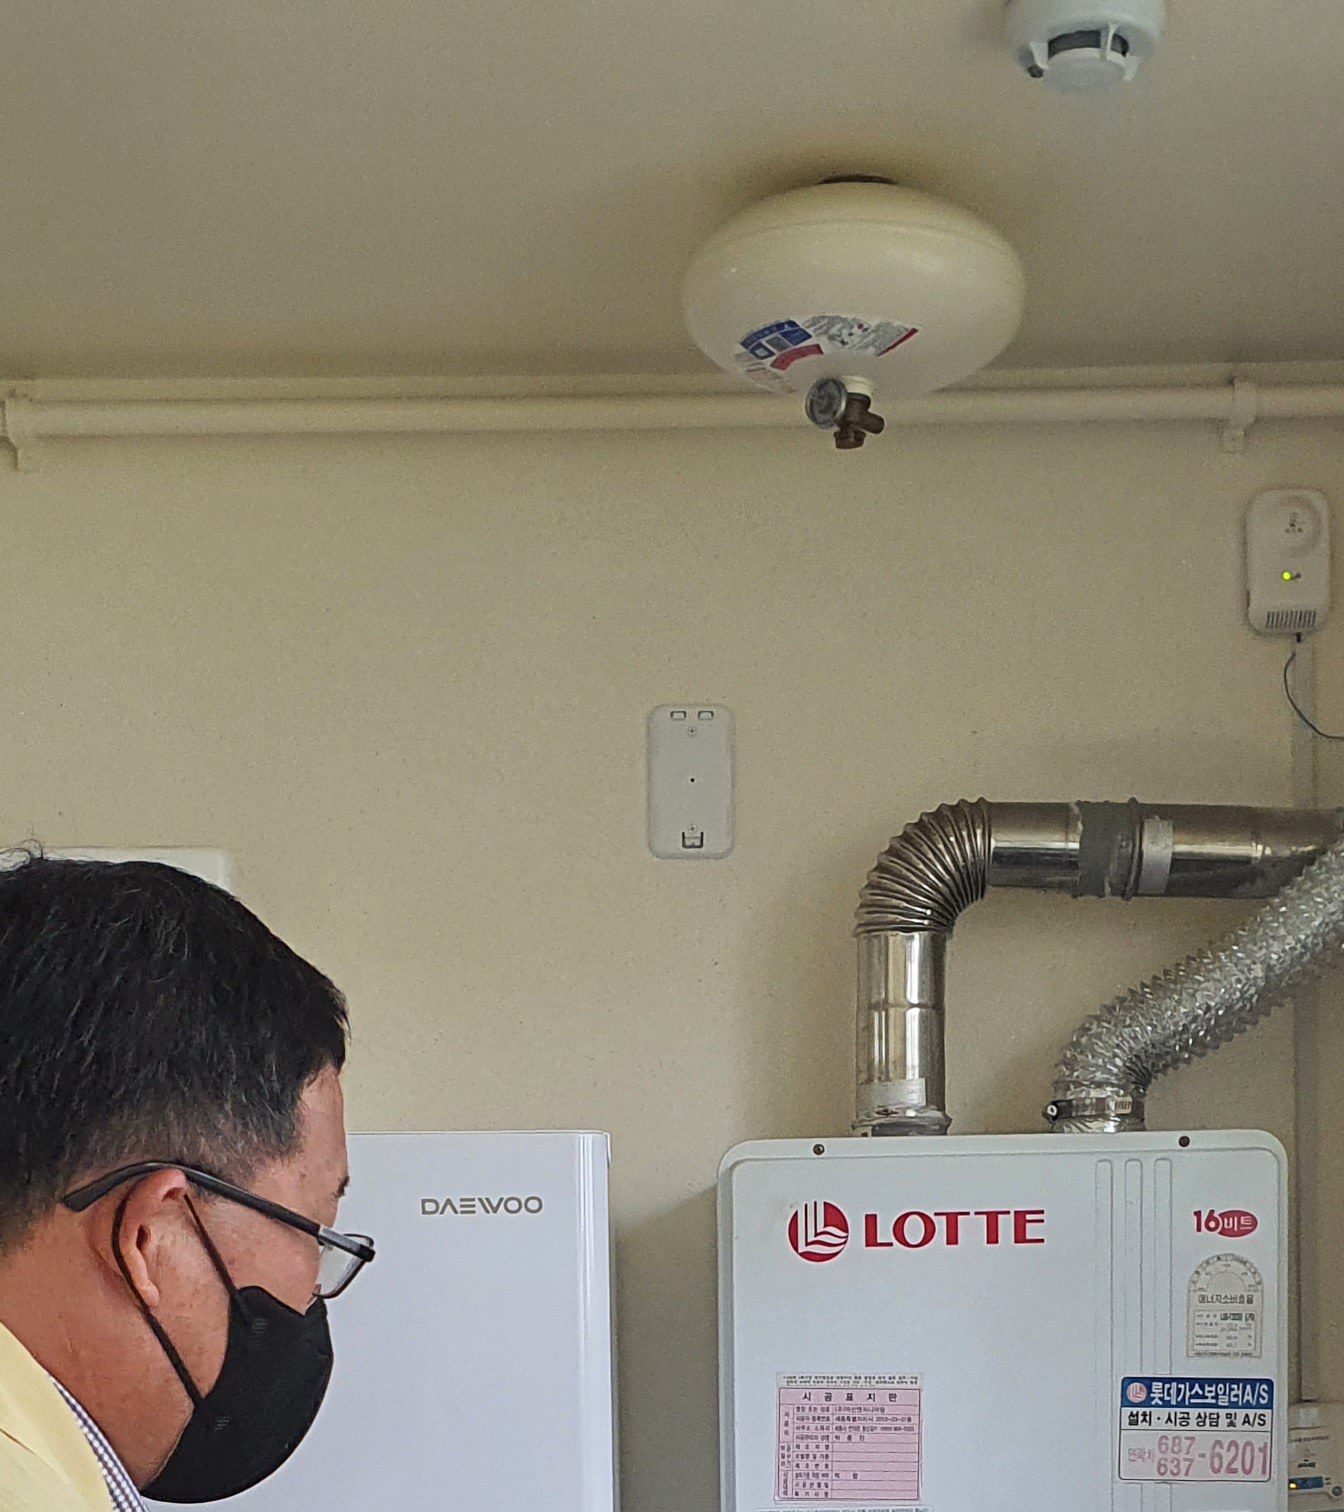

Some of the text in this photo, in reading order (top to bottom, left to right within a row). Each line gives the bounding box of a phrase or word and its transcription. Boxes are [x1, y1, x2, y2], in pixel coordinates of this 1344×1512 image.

[420, 1195, 544, 1216] DAEWOO
[864, 1210, 1046, 1249] LOTTE
[1192, 1208, 1255, 1234] 16비트
[1149, 1381, 1270, 1406] 롯데가스보일러A/S
[1194, 1411, 1221, 1428] 상담
[1224, 1412, 1239, 1429] 및
[1241, 1412, 1268, 1428] A/S
